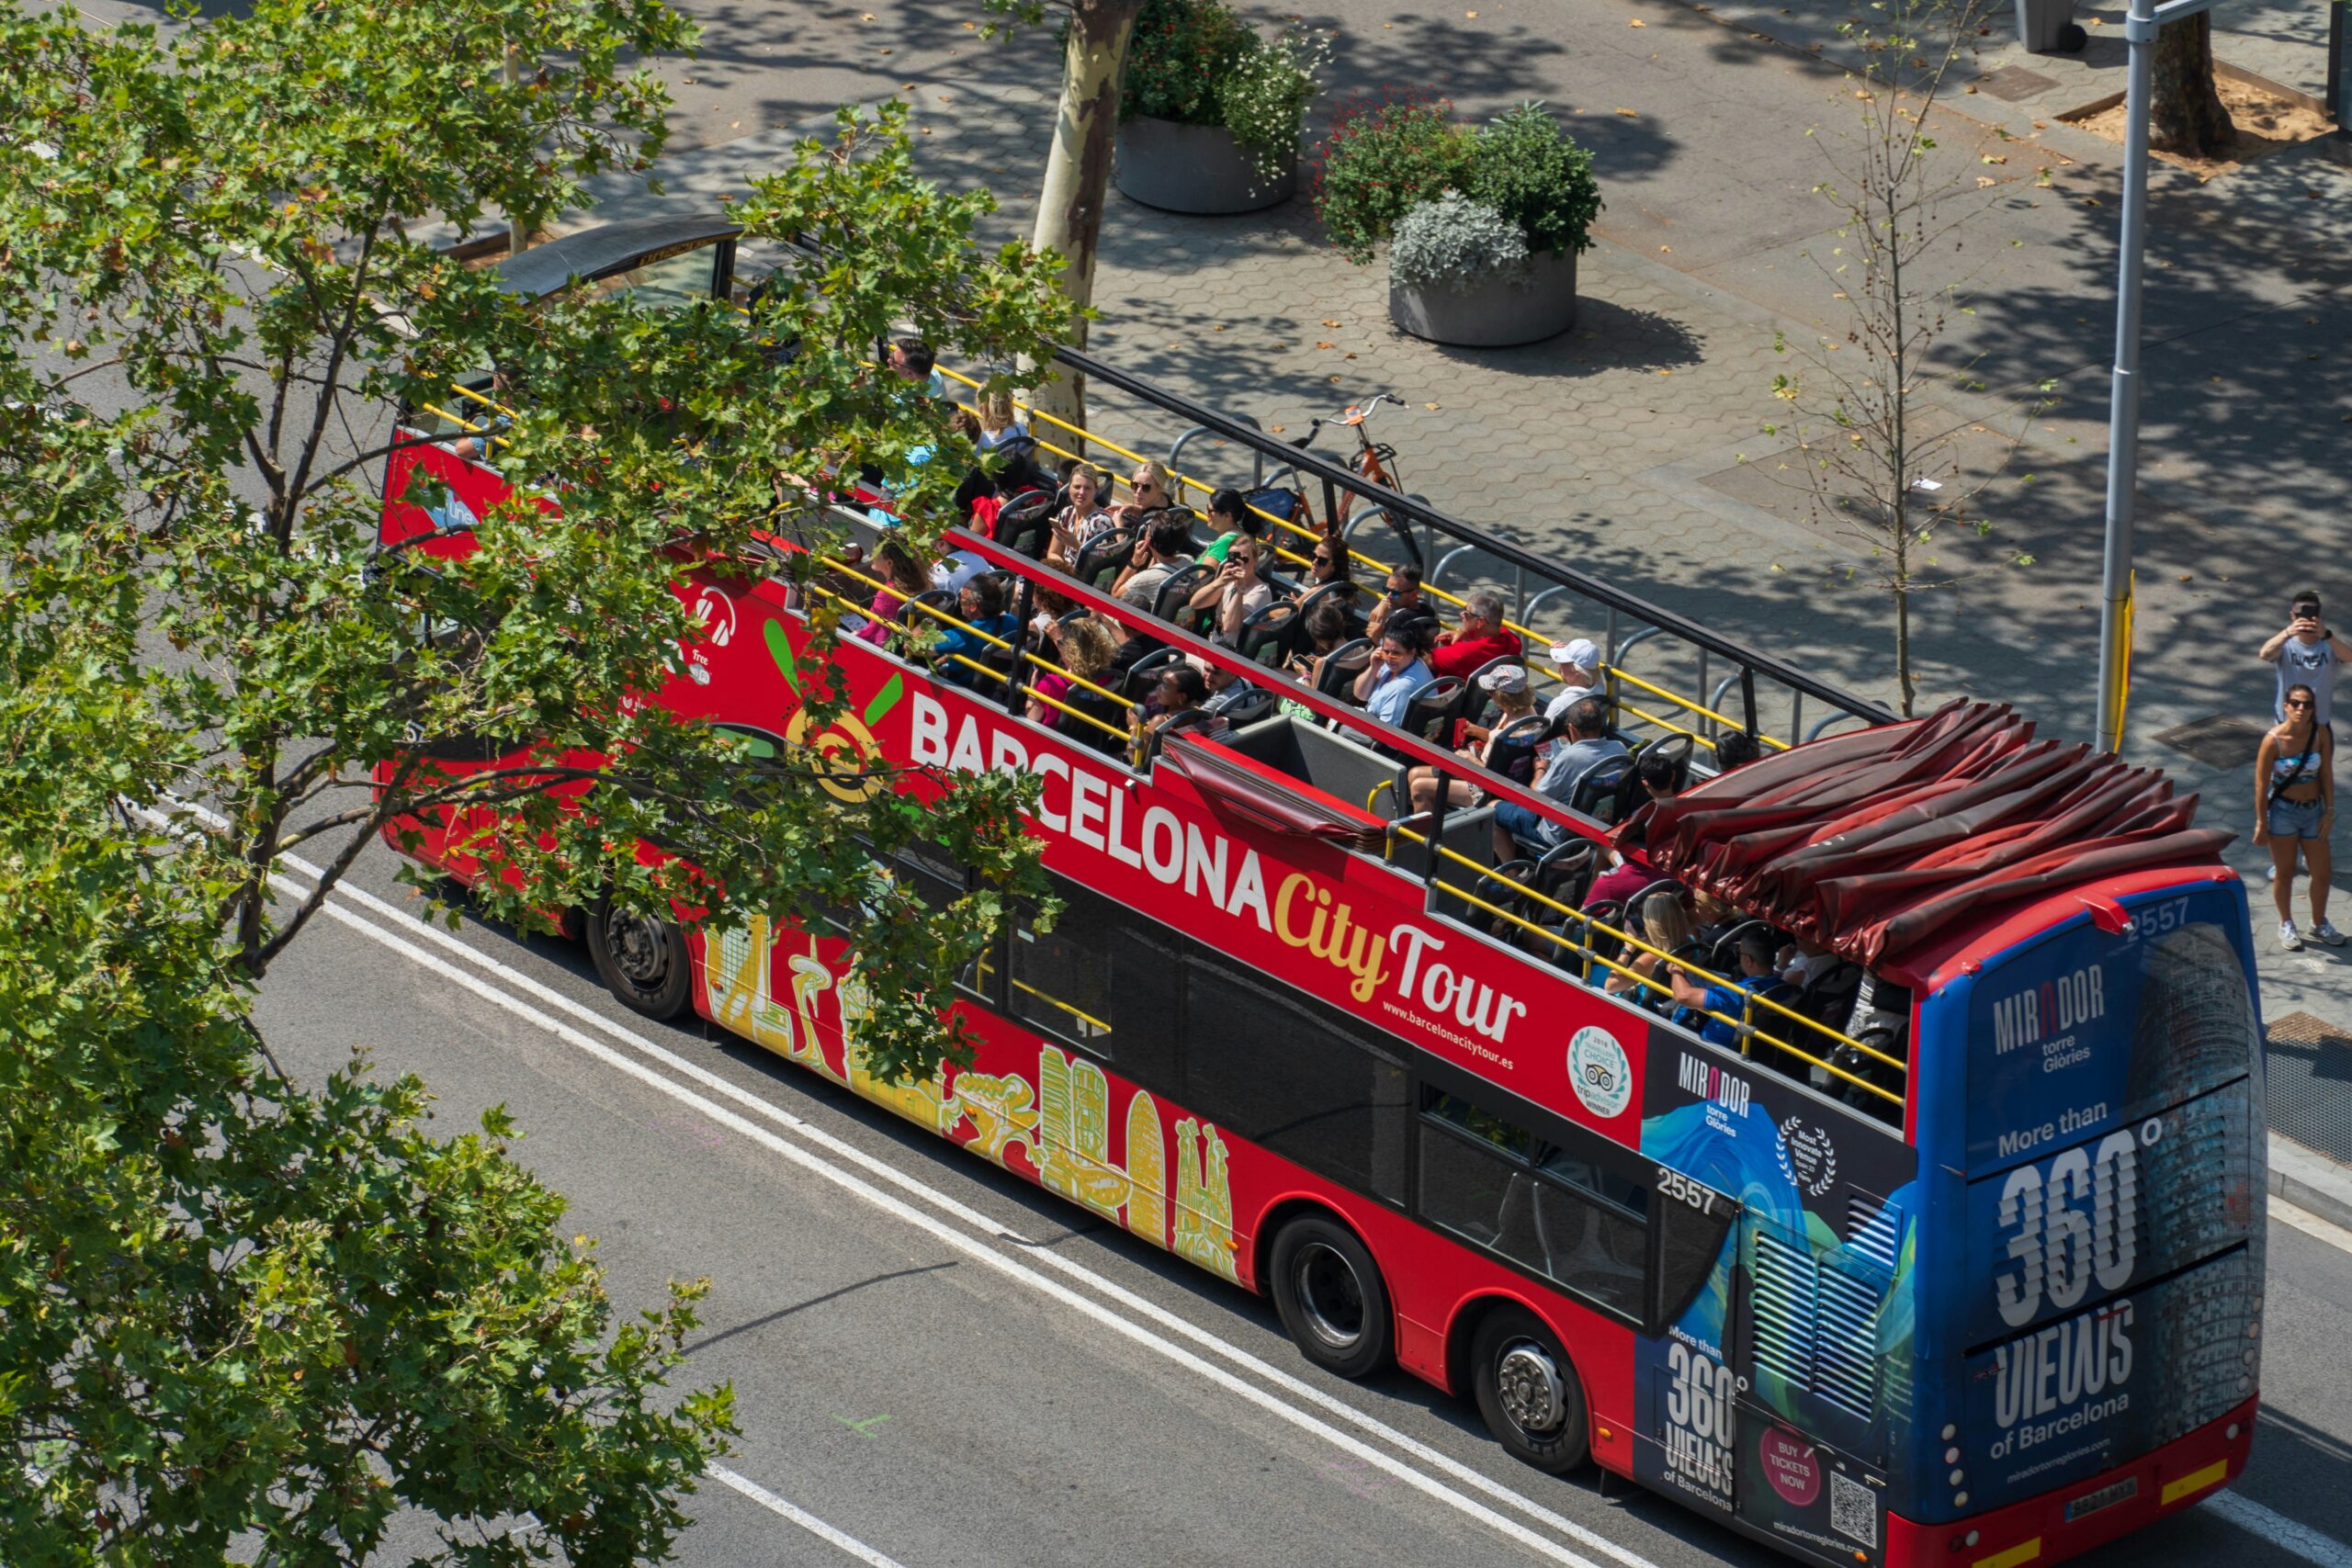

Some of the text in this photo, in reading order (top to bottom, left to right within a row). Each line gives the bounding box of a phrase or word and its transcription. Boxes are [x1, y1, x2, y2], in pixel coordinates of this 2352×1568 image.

[693, 649, 709, 666] Free
[910, 691, 1526, 1043] BARCELONA City Tour
[2127, 897, 2189, 943] 2557
[1993, 964, 2104, 1055] MIRADOR
[1383, 1000, 1513, 1070] www.barcelonacitytour.es
[2041, 1035, 2075, 1057] torre
[1584, 1049, 1614, 1069] CHOICE
[2043, 1045, 2091, 1074] Glòries
[1577, 1084, 1618, 1110] tripadvisor
[1679, 1051, 1750, 1119] MIRADOR
[1586, 1100, 1611, 1116] WINNER
[1706, 1104, 1728, 1122] torre
[1705, 1114, 1736, 1138] Glòries
[1798, 1130, 1817, 1146] Most
[1997, 1101, 2108, 1159] More than
[1794, 1147, 1817, 1166] Venue
[1657, 1168, 1716, 1216] 2557
[1668, 1325, 1723, 1360] More than
[1995, 1299, 2133, 1428] VIEWS
[1990, 1393, 2130, 1460] of Barcelona
[1666, 1420, 1734, 1497] VIEWS
[1778, 1441, 1798, 1458] BUY
[1769, 1453, 1811, 1477] TICKETS
[1664, 1471, 1734, 1513] of Barcelona
[1780, 1472, 1805, 1491] NOW
